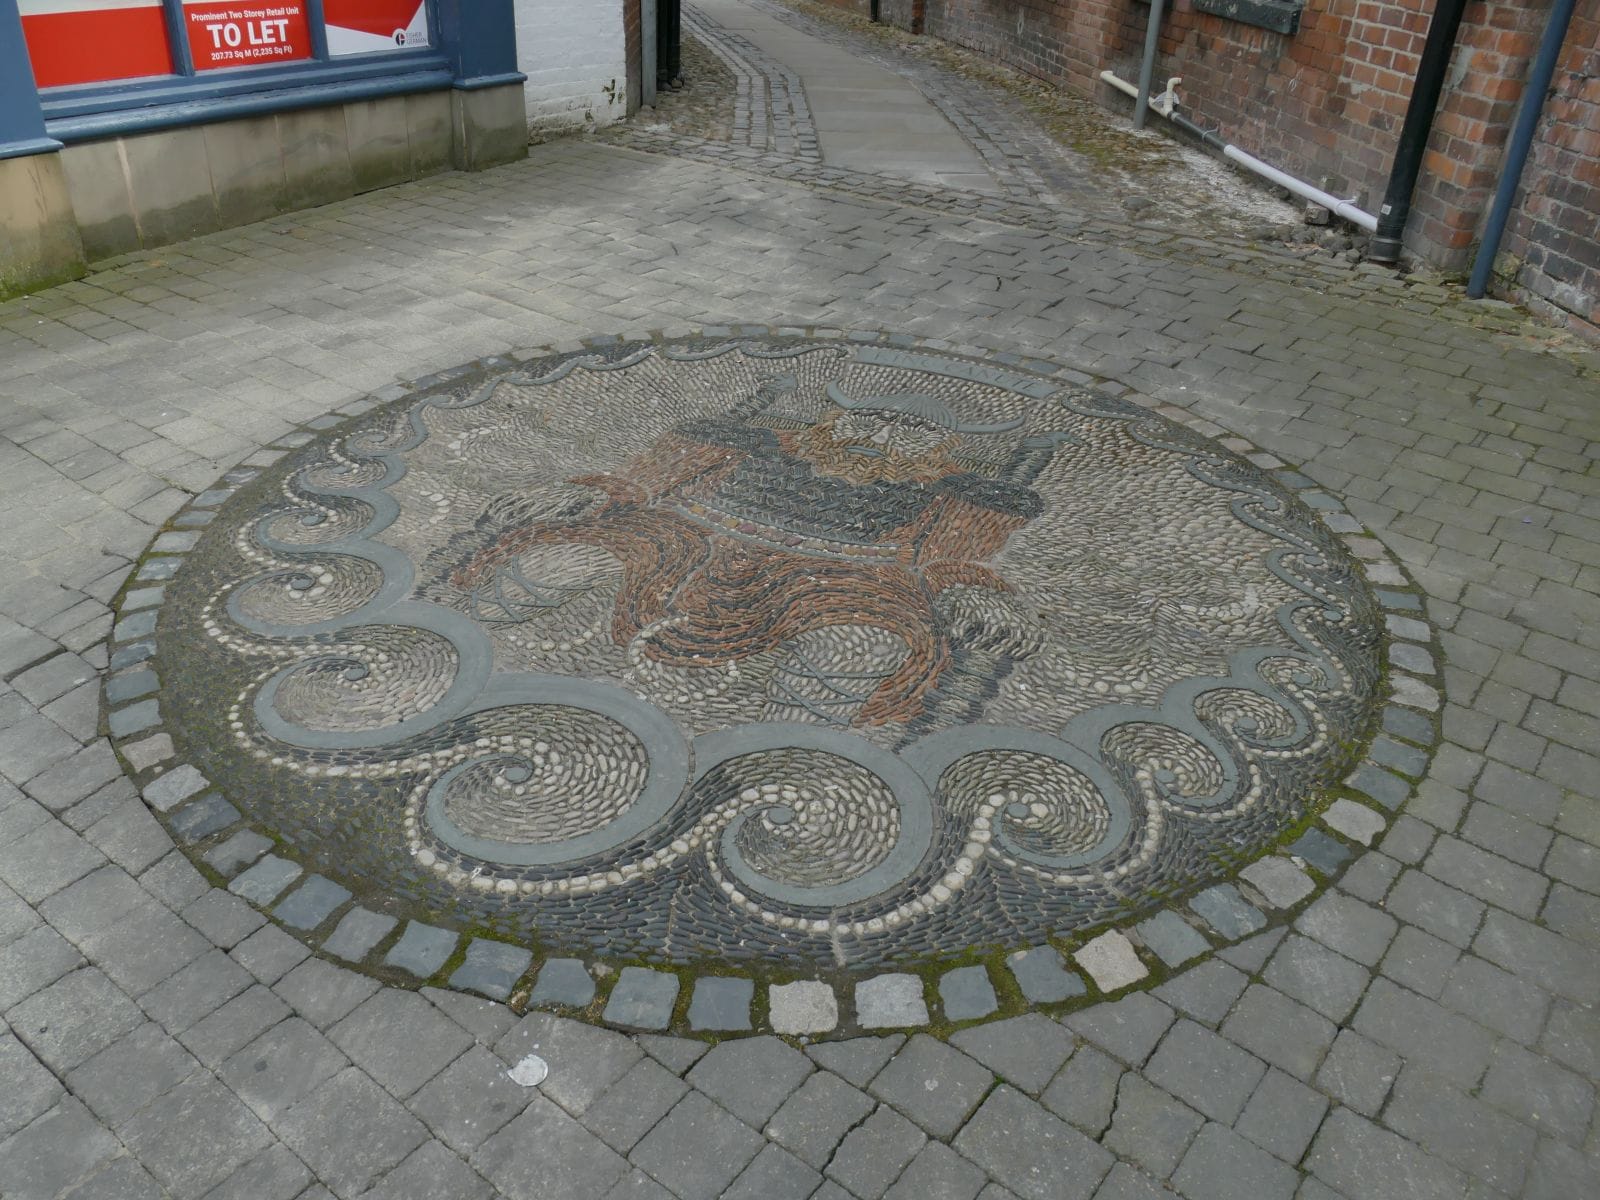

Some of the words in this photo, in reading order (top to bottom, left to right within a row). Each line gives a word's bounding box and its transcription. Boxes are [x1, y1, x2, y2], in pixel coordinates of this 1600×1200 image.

[191, 11, 228, 21] Prominent
[228, 10, 243, 19] Two
[243, 9, 265, 18] Storey
[266, 7, 285, 17] Retail
[285, 7, 299, 15] Unit
[206, 23, 242, 48] TO
[247, 19, 289, 45] LET
[211, 51, 234, 60] 207.73
[234, 50, 244, 59] Sq
[244, 49, 252, 57] M
[252, 46, 273, 58] (2,235
[273, 46, 283, 55] Sq
[283, 45, 293, 54] Ft)
